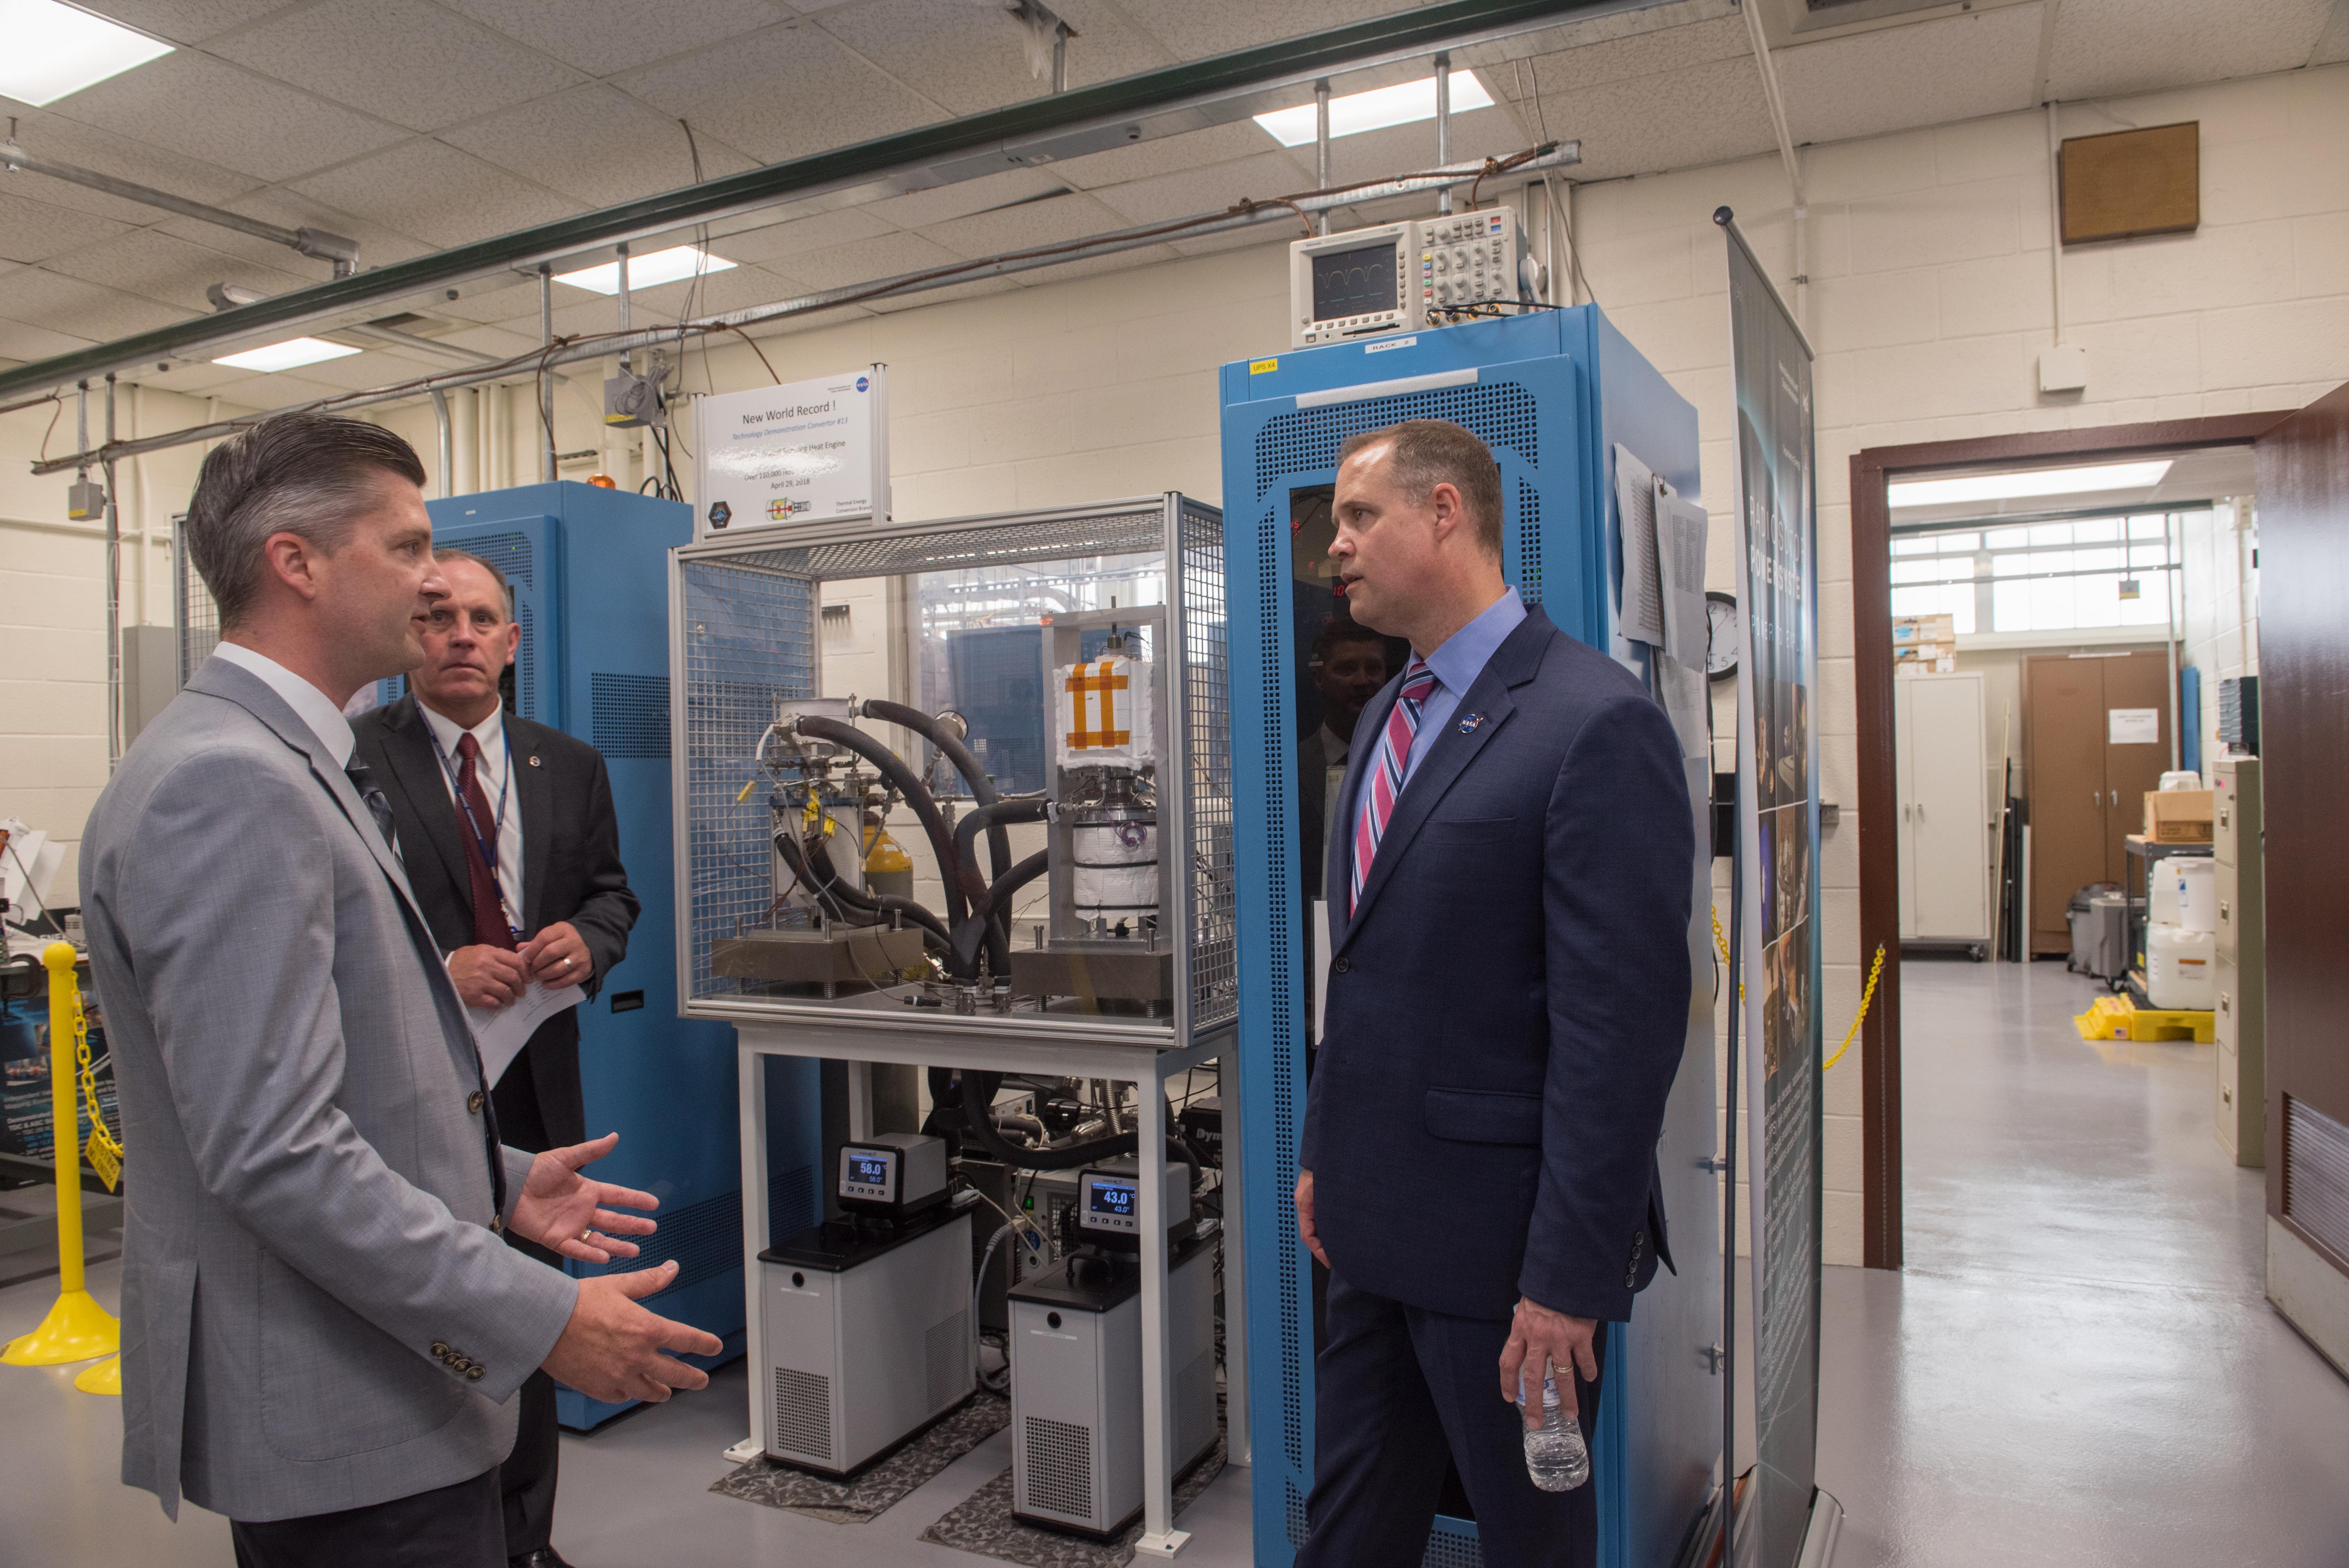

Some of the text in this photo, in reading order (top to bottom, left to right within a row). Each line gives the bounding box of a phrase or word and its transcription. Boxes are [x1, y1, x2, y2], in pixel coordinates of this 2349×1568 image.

[743, 400, 836, 425] New World Record !
[733, 429, 763, 440] Technology
[764, 424, 806, 436] Demonstration
[807, 419, 836, 429] Convertor
[825, 440, 846, 449] Engine
[759, 470, 781, 479] 110,000
[770, 481, 784, 490] April
[1721, 656, 1728, 668] 5
[860, 1162, 881, 1175] 58.0
[1103, 1191, 1128, 1205] 43.0
